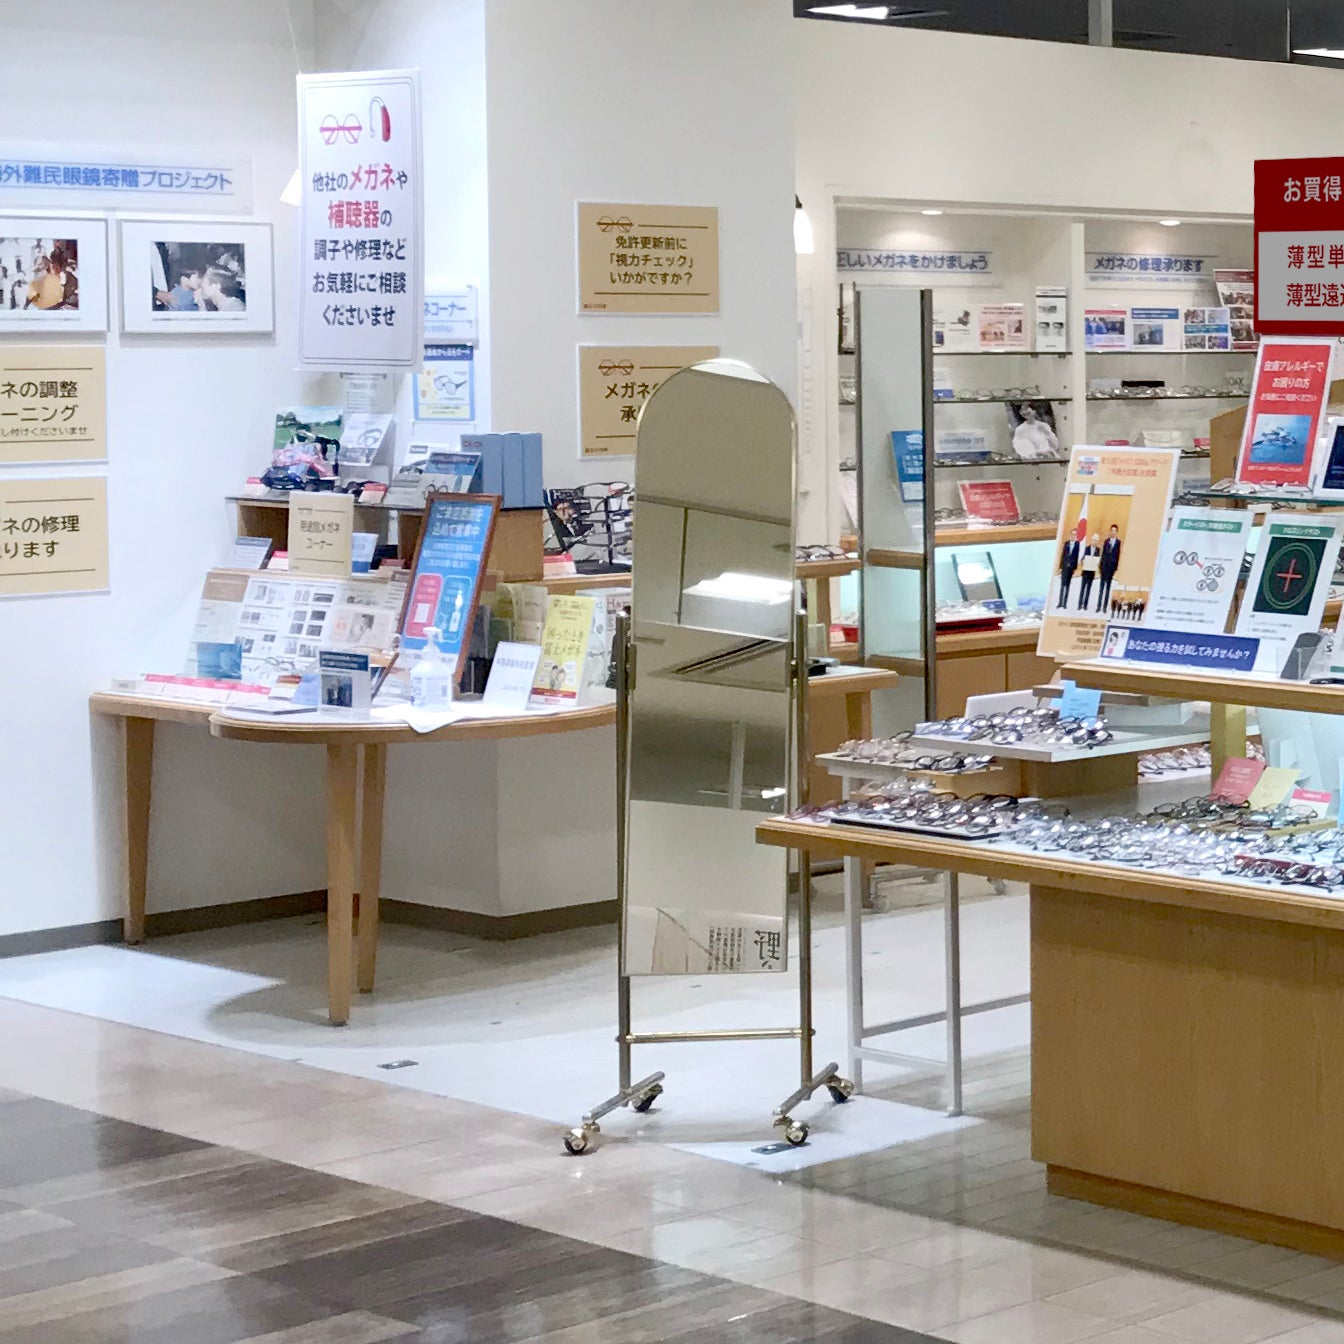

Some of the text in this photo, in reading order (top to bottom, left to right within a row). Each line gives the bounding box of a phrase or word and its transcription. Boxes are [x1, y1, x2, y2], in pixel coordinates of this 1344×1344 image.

[312, 163, 408, 192] 他社のメガネや
[328, 200, 393, 229] 補聴器の
[314, 238, 407, 261] 調子や修理など
[615, 236, 688, 250] 免許更新前に
[609, 253, 694, 269] 「視力チェック」
[312, 271, 407, 294] お気軽にご相談
[322, 304, 396, 327] くださいませ
[605, 382, 658, 399] メガネ
